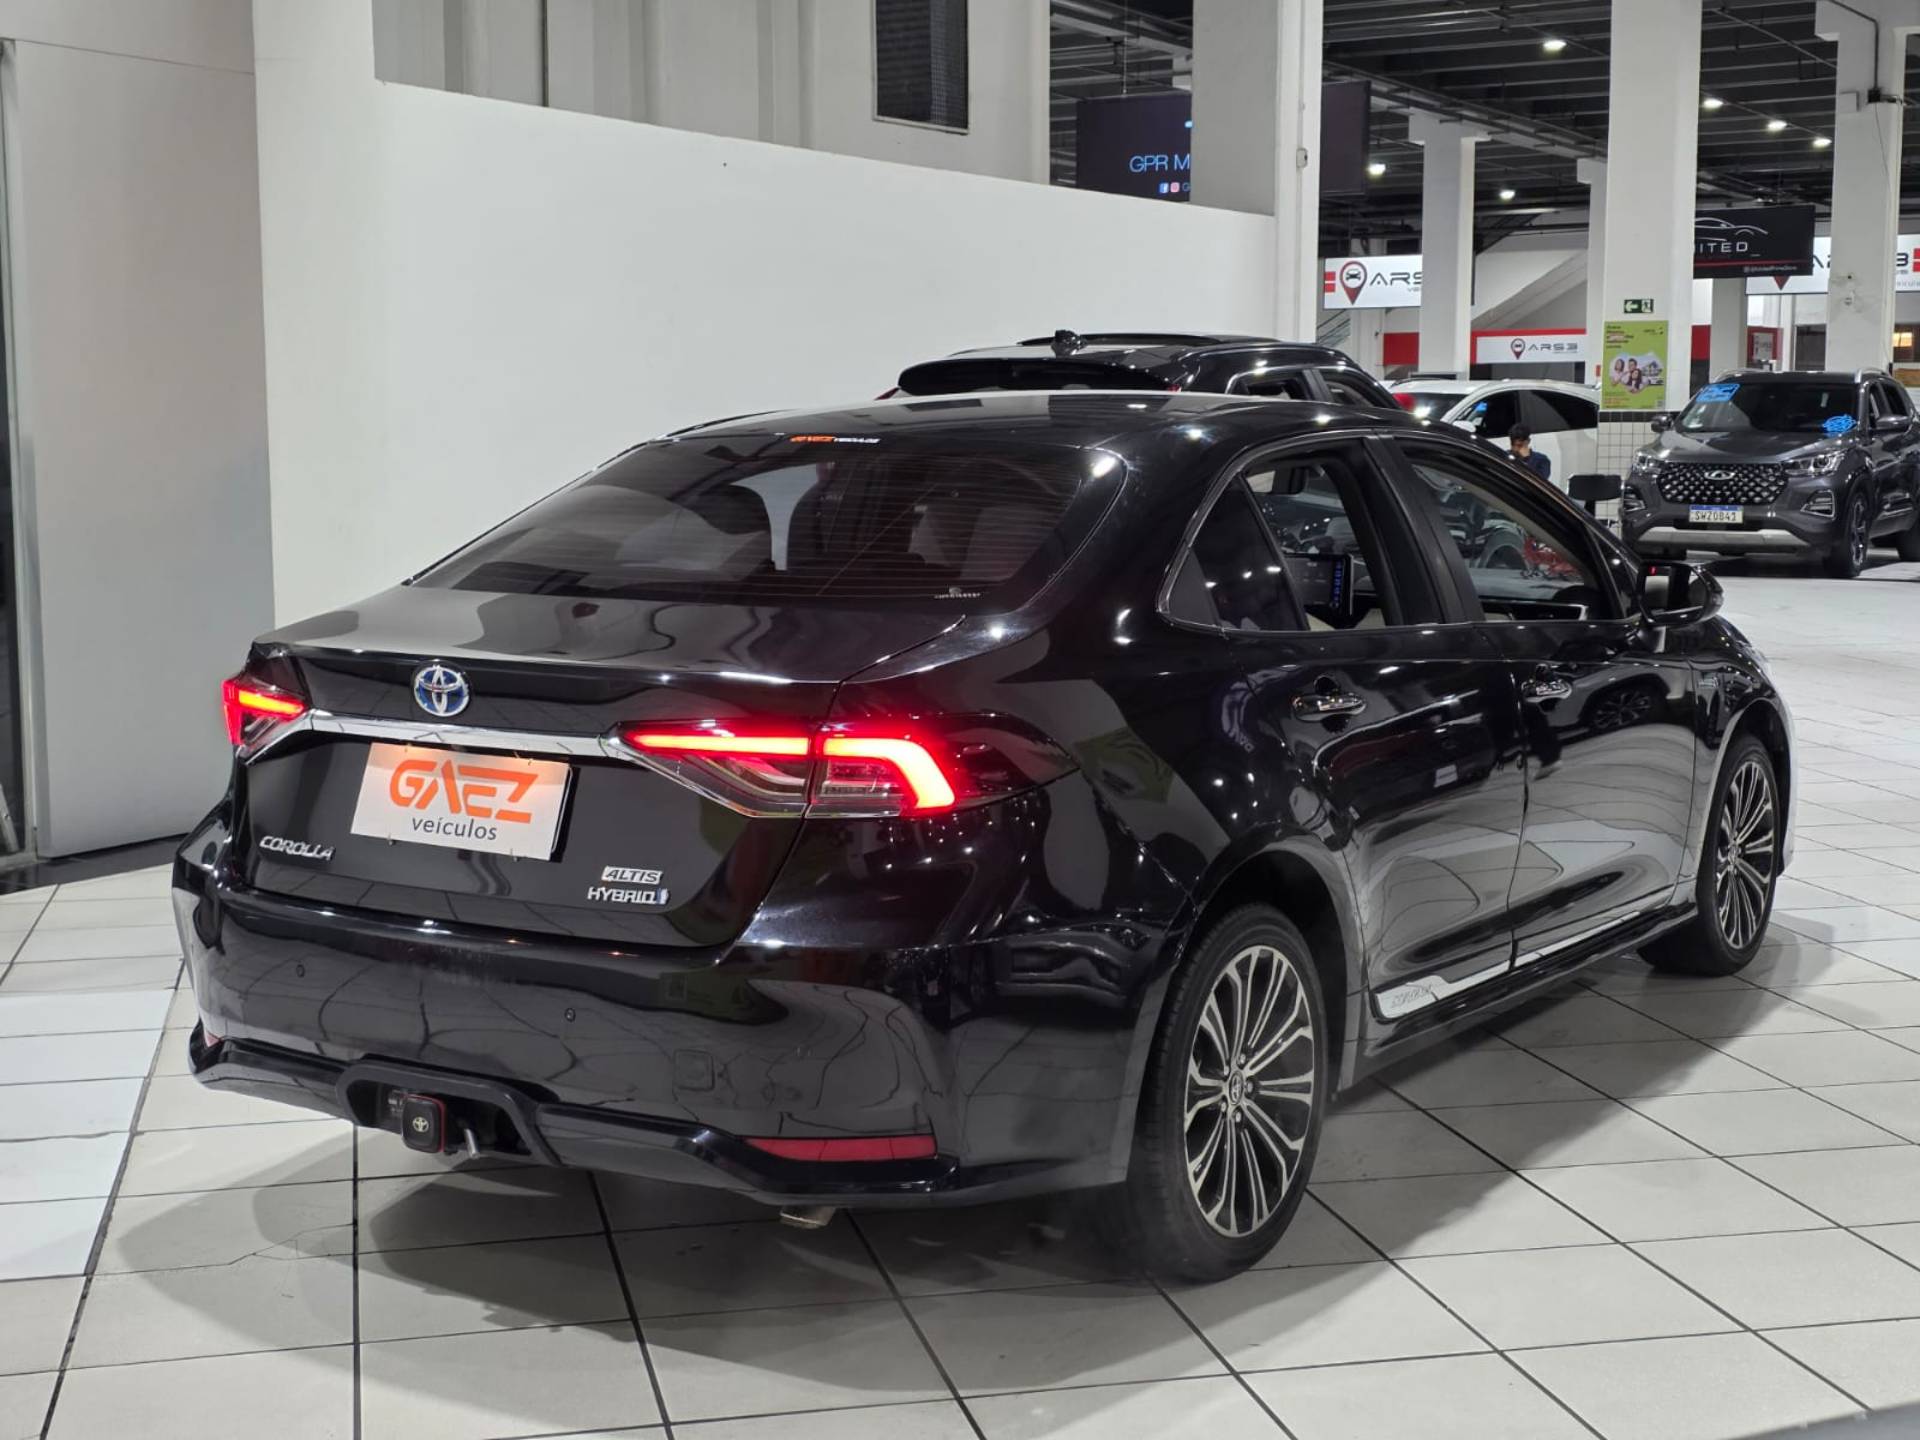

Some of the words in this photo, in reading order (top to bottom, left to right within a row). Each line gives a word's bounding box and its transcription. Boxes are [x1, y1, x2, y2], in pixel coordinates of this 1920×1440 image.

[1129, 154, 1169, 173] GPR
[389, 759, 539, 824] GAEZ
[412, 816, 497, 841] veículos
[259, 835, 334, 861] COROLLA
[605, 869, 660, 883] ALTIS
[587, 886, 658, 905] HYBRID
